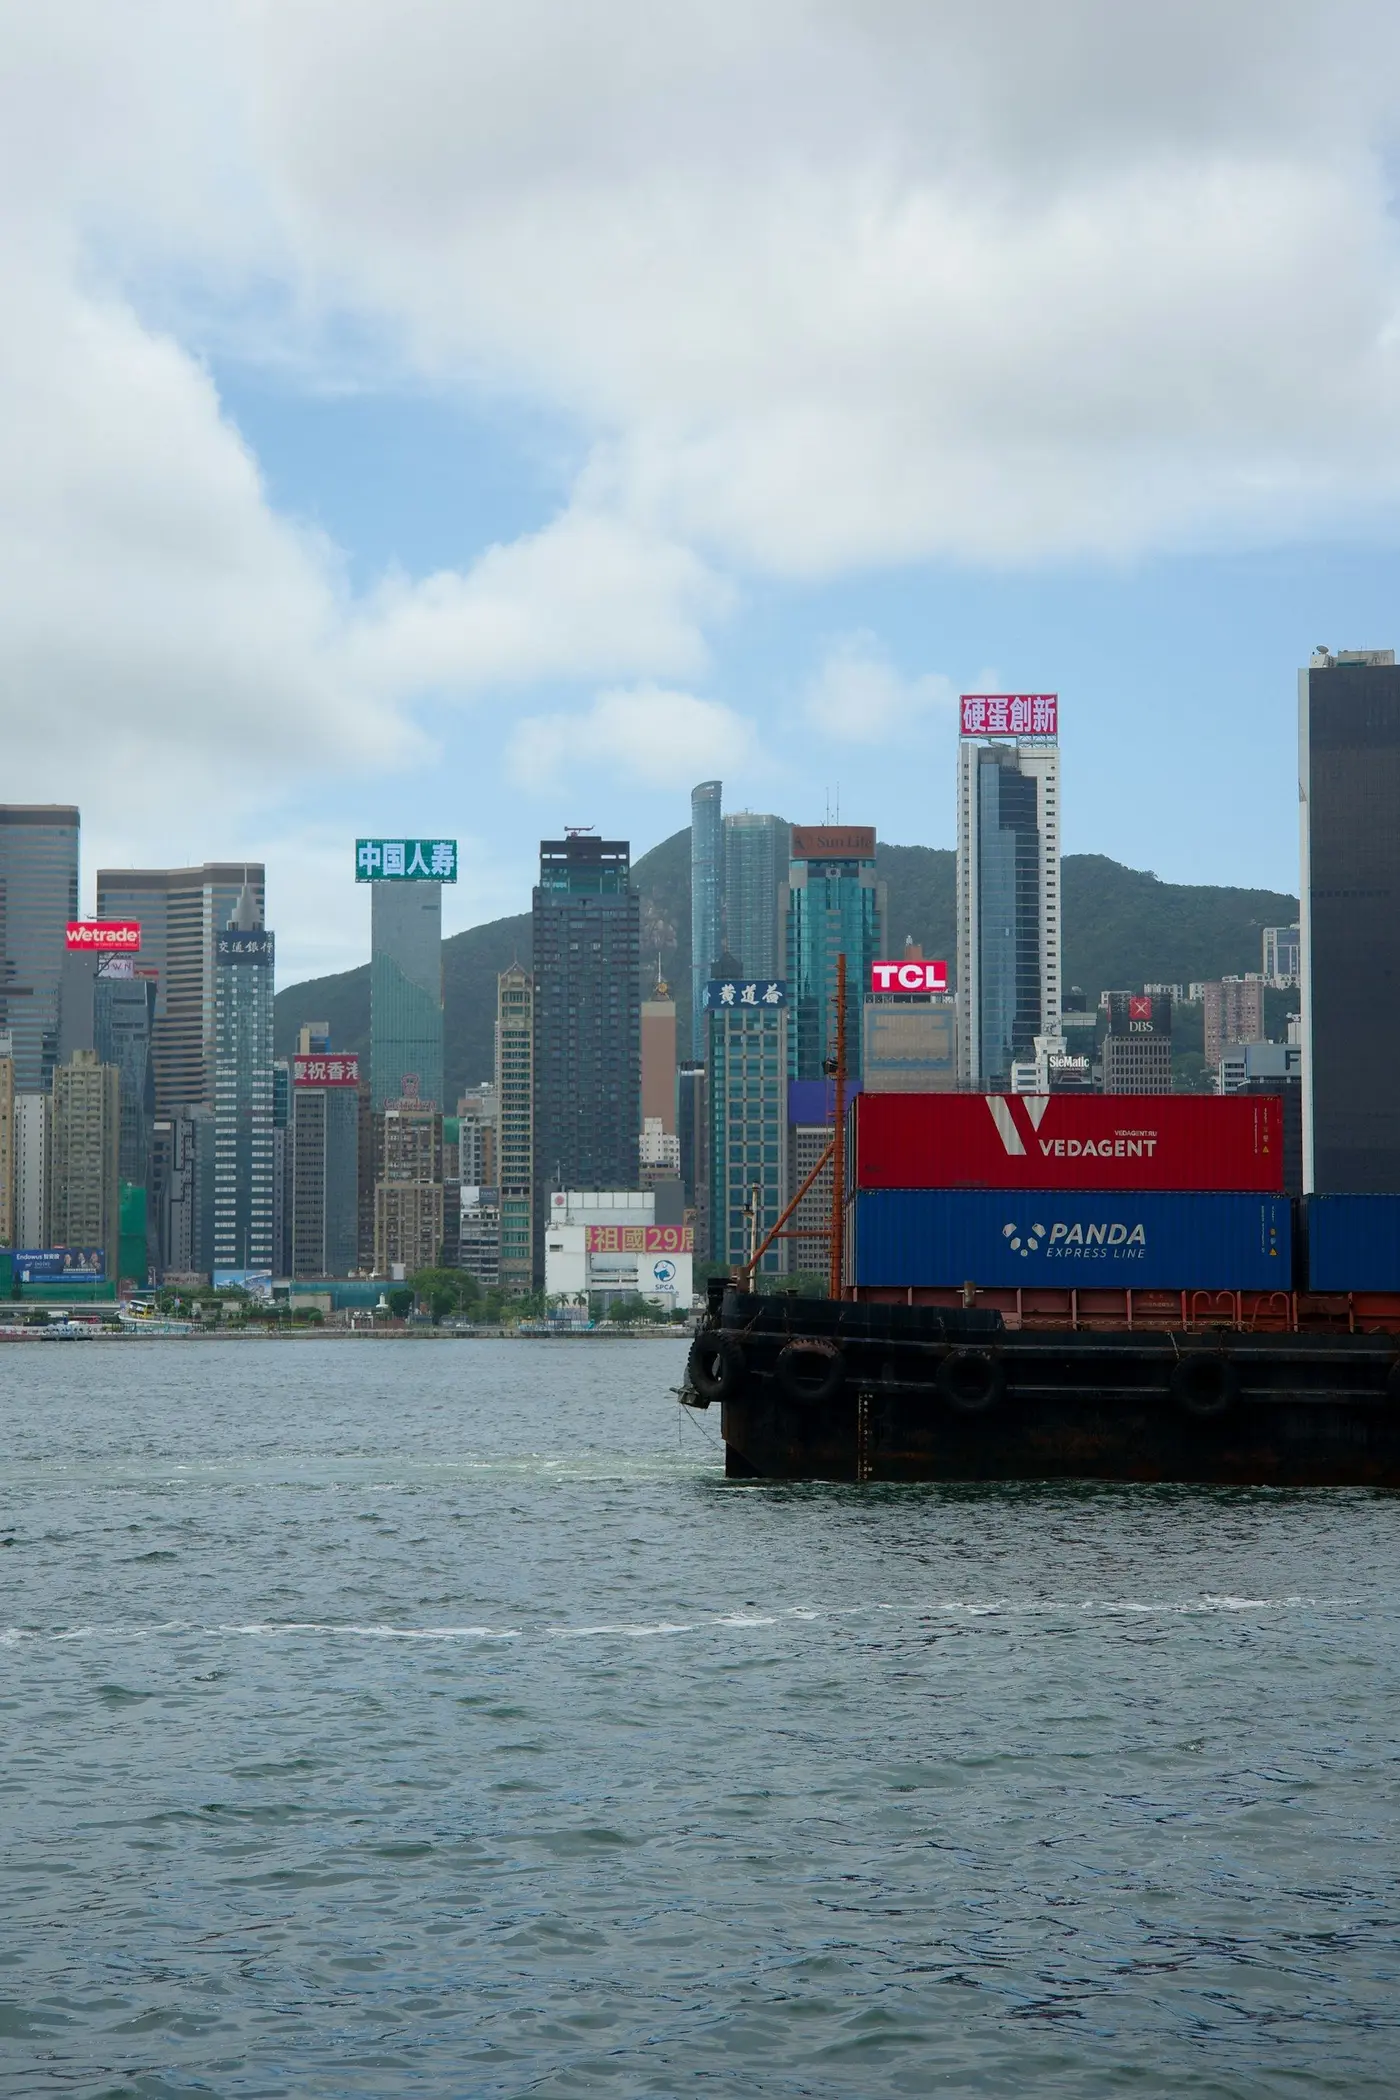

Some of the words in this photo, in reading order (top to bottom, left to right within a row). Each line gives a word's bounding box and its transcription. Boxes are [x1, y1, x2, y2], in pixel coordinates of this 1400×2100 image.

[963, 696, 1055, 732] 硬蛋創新
[818, 835, 843, 848] Sun
[847, 835, 872, 848] Life
[358, 841, 455, 876] 中国人寿
[218, 941, 274, 953] 交通銀行
[873, 964, 946, 989] TCL
[1129, 1021, 1154, 1032] DBS
[1049, 1055, 1090, 1068] SieMatic
[1038, 1139, 1157, 1157] VEDAGENT
[1049, 1223, 1146, 1245] PANDA
[1046, 1247, 1107, 1258] EXPRESS
[1113, 1248, 1146, 1258] LINE
